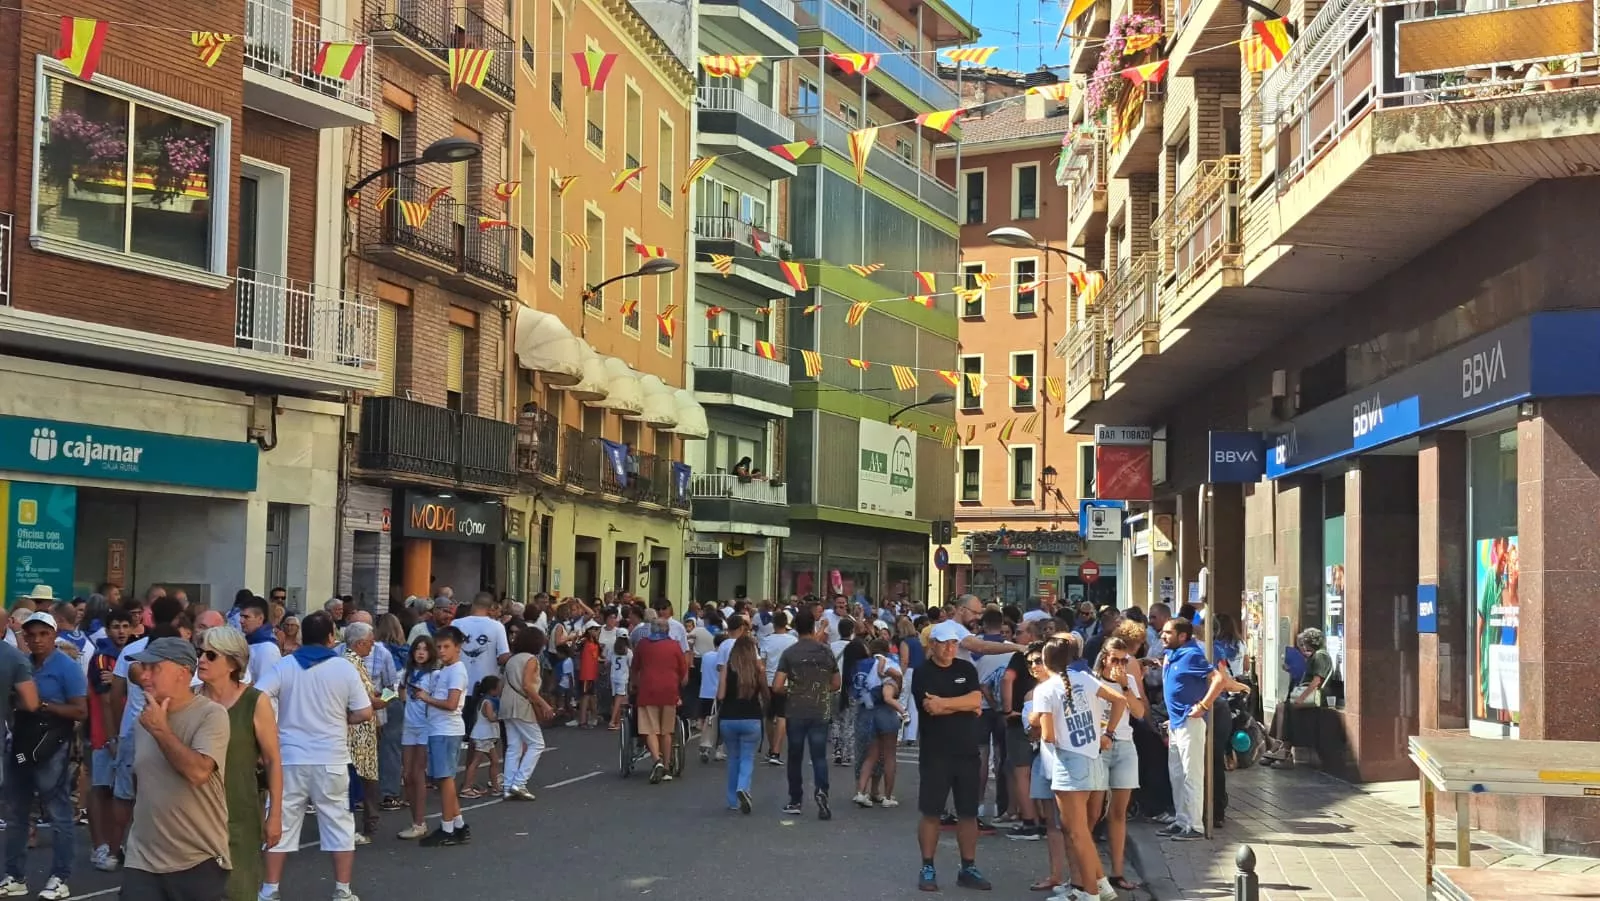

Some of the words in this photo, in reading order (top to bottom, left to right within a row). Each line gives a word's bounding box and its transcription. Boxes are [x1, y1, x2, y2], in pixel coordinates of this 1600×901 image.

[1462, 340, 1506, 398] BBVA
[1353, 392, 1384, 438] BBVA
[1100, 430, 1115, 439] BAR
[1121, 430, 1150, 440] TOBAZO
[62, 435, 144, 466] cajamar
[1215, 449, 1259, 463] BBVA
[411, 503, 456, 532] MODA
[17, 528, 45, 540] Oficina
[46, 531, 60, 540] con
[16, 539, 65, 551] Autoservicio
[614, 656, 622, 671] 5
[1070, 725, 1097, 748] CA
